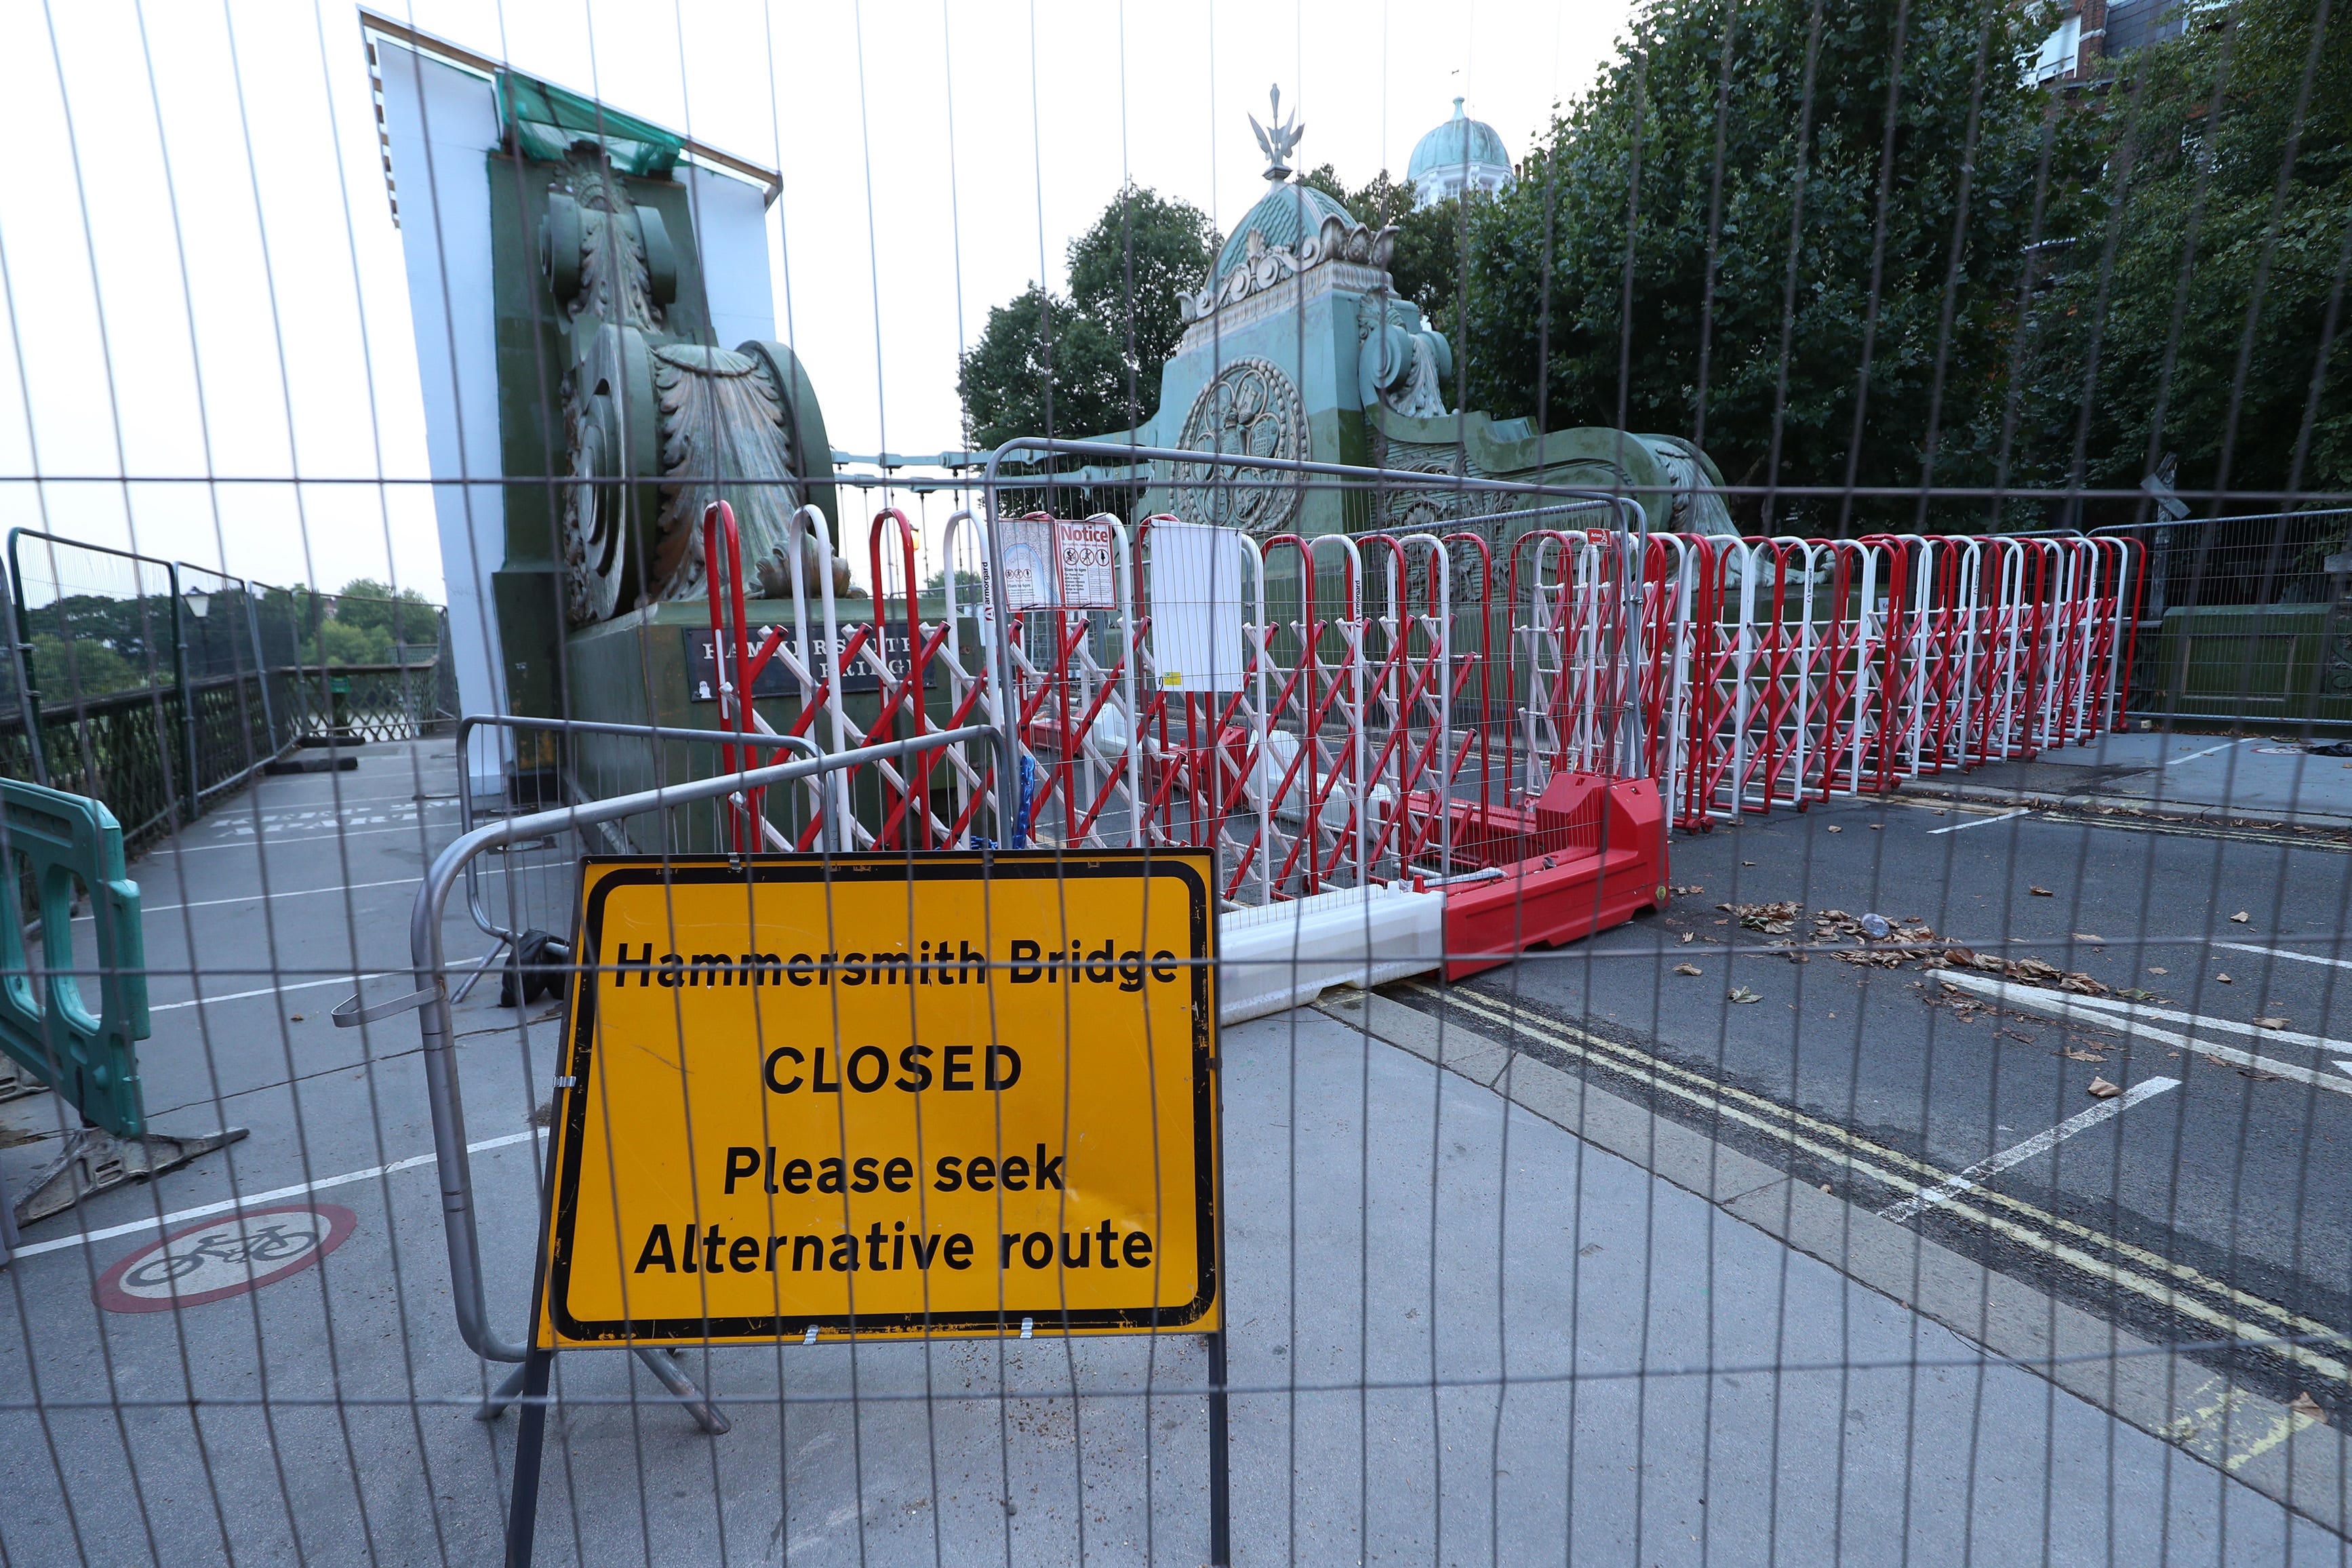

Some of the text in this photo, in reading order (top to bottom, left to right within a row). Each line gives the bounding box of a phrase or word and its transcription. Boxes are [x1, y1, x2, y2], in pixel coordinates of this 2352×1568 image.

[1061, 526, 1109, 542] Notice
[982, 561, 990, 605] armorgard
[615, 939, 1177, 992] Hammersmith Bridge
[763, 1045, 1022, 1094] CLOSED
[724, 1143, 1067, 1195] Please seek
[634, 1218, 1154, 1274] Alternative route
